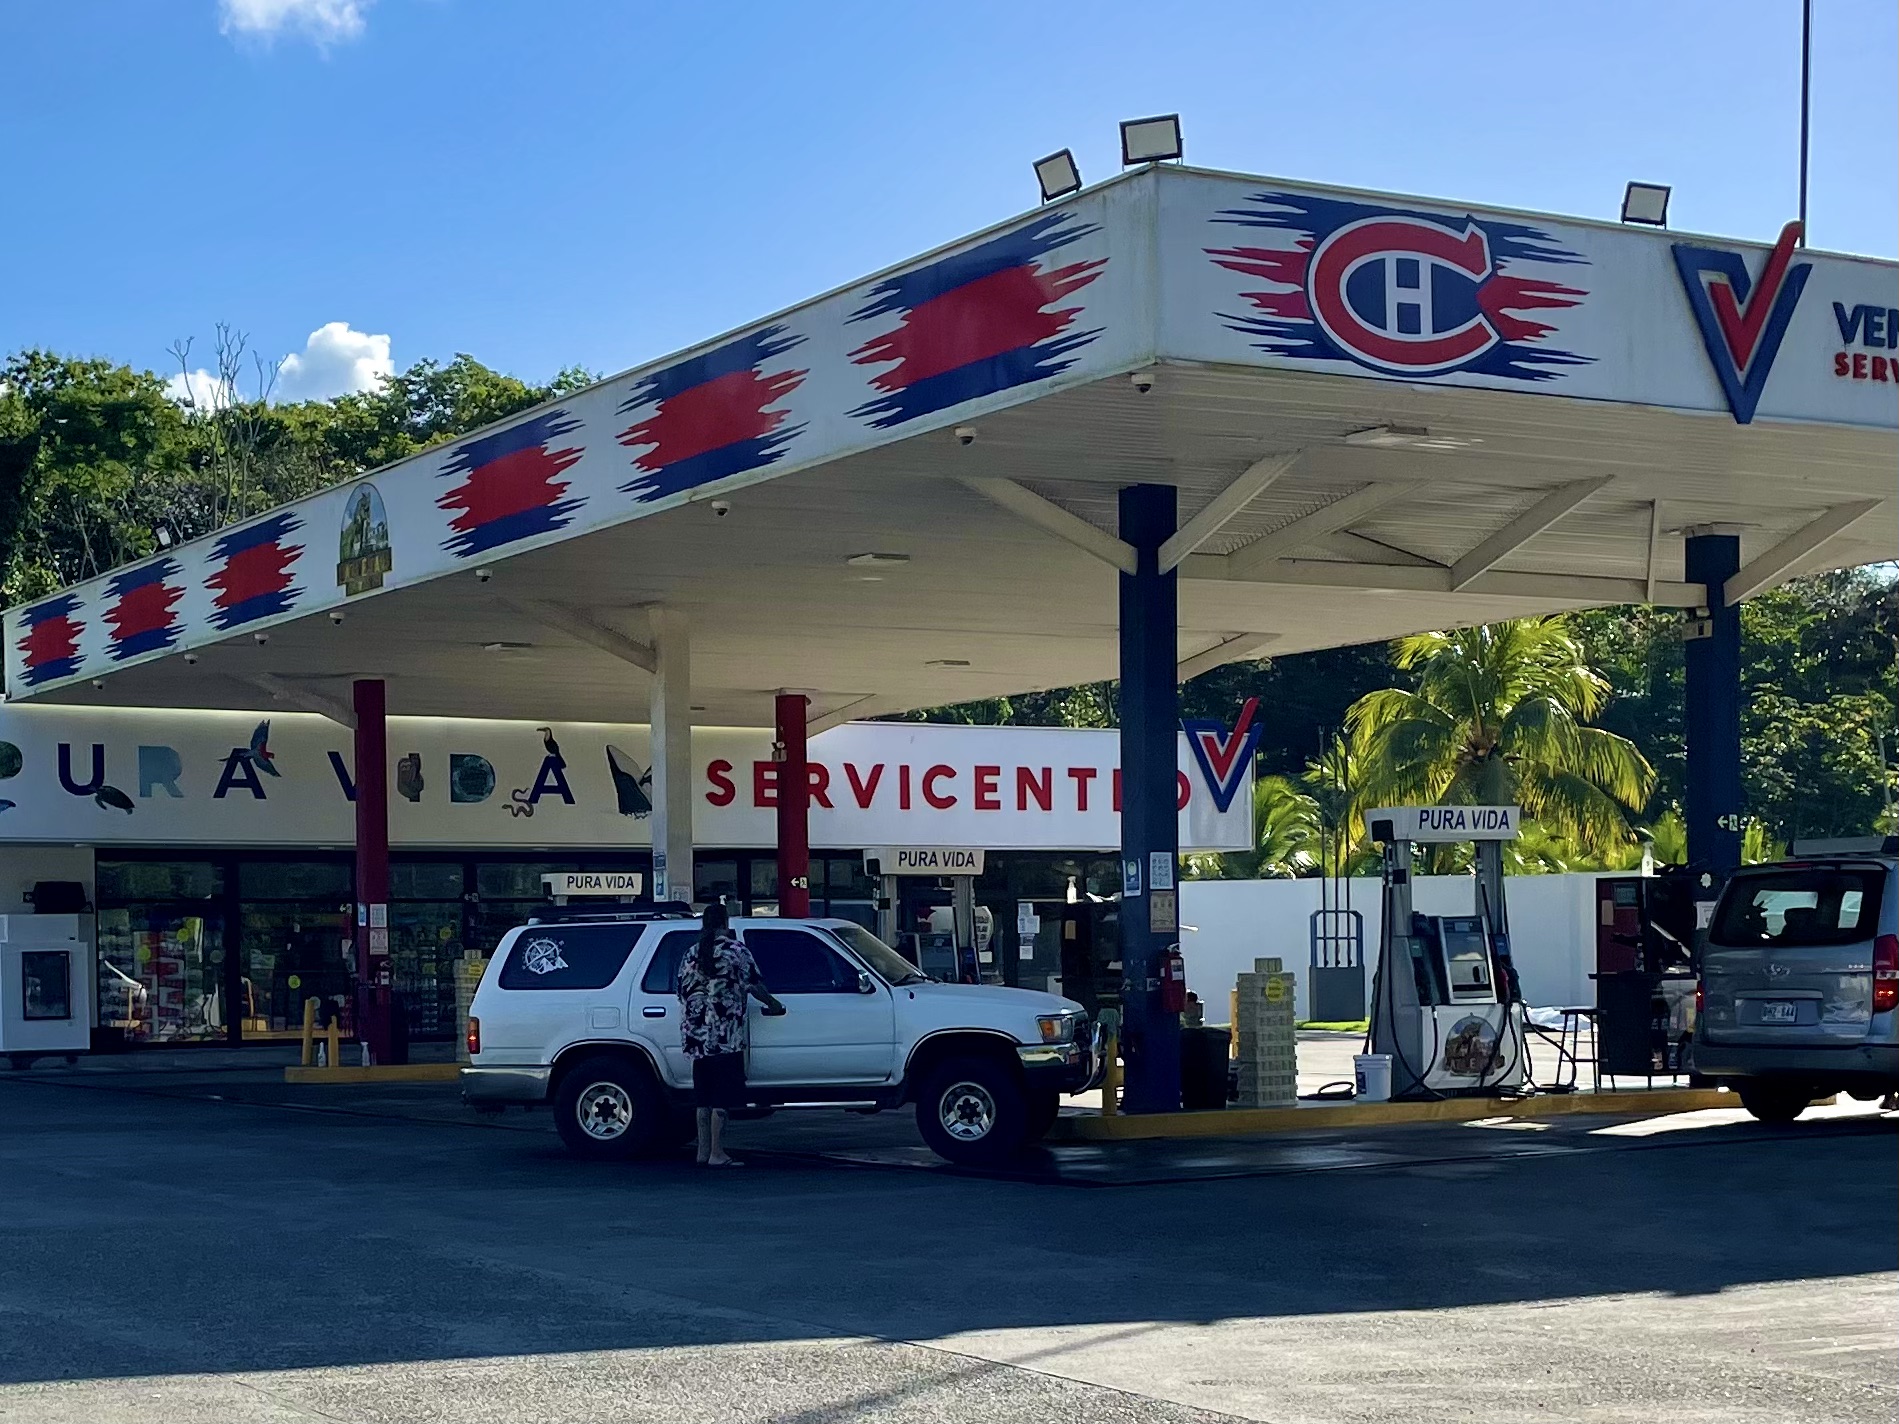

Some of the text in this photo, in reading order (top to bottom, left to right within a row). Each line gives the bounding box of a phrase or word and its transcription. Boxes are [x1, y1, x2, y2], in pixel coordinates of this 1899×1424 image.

[705, 759, 1191, 812] SERVICENT
[1419, 809, 1510, 830] PURA VIDA
[898, 850, 976, 867] PURA VIDA
[566, 875, 635, 889] PURA VIDA
